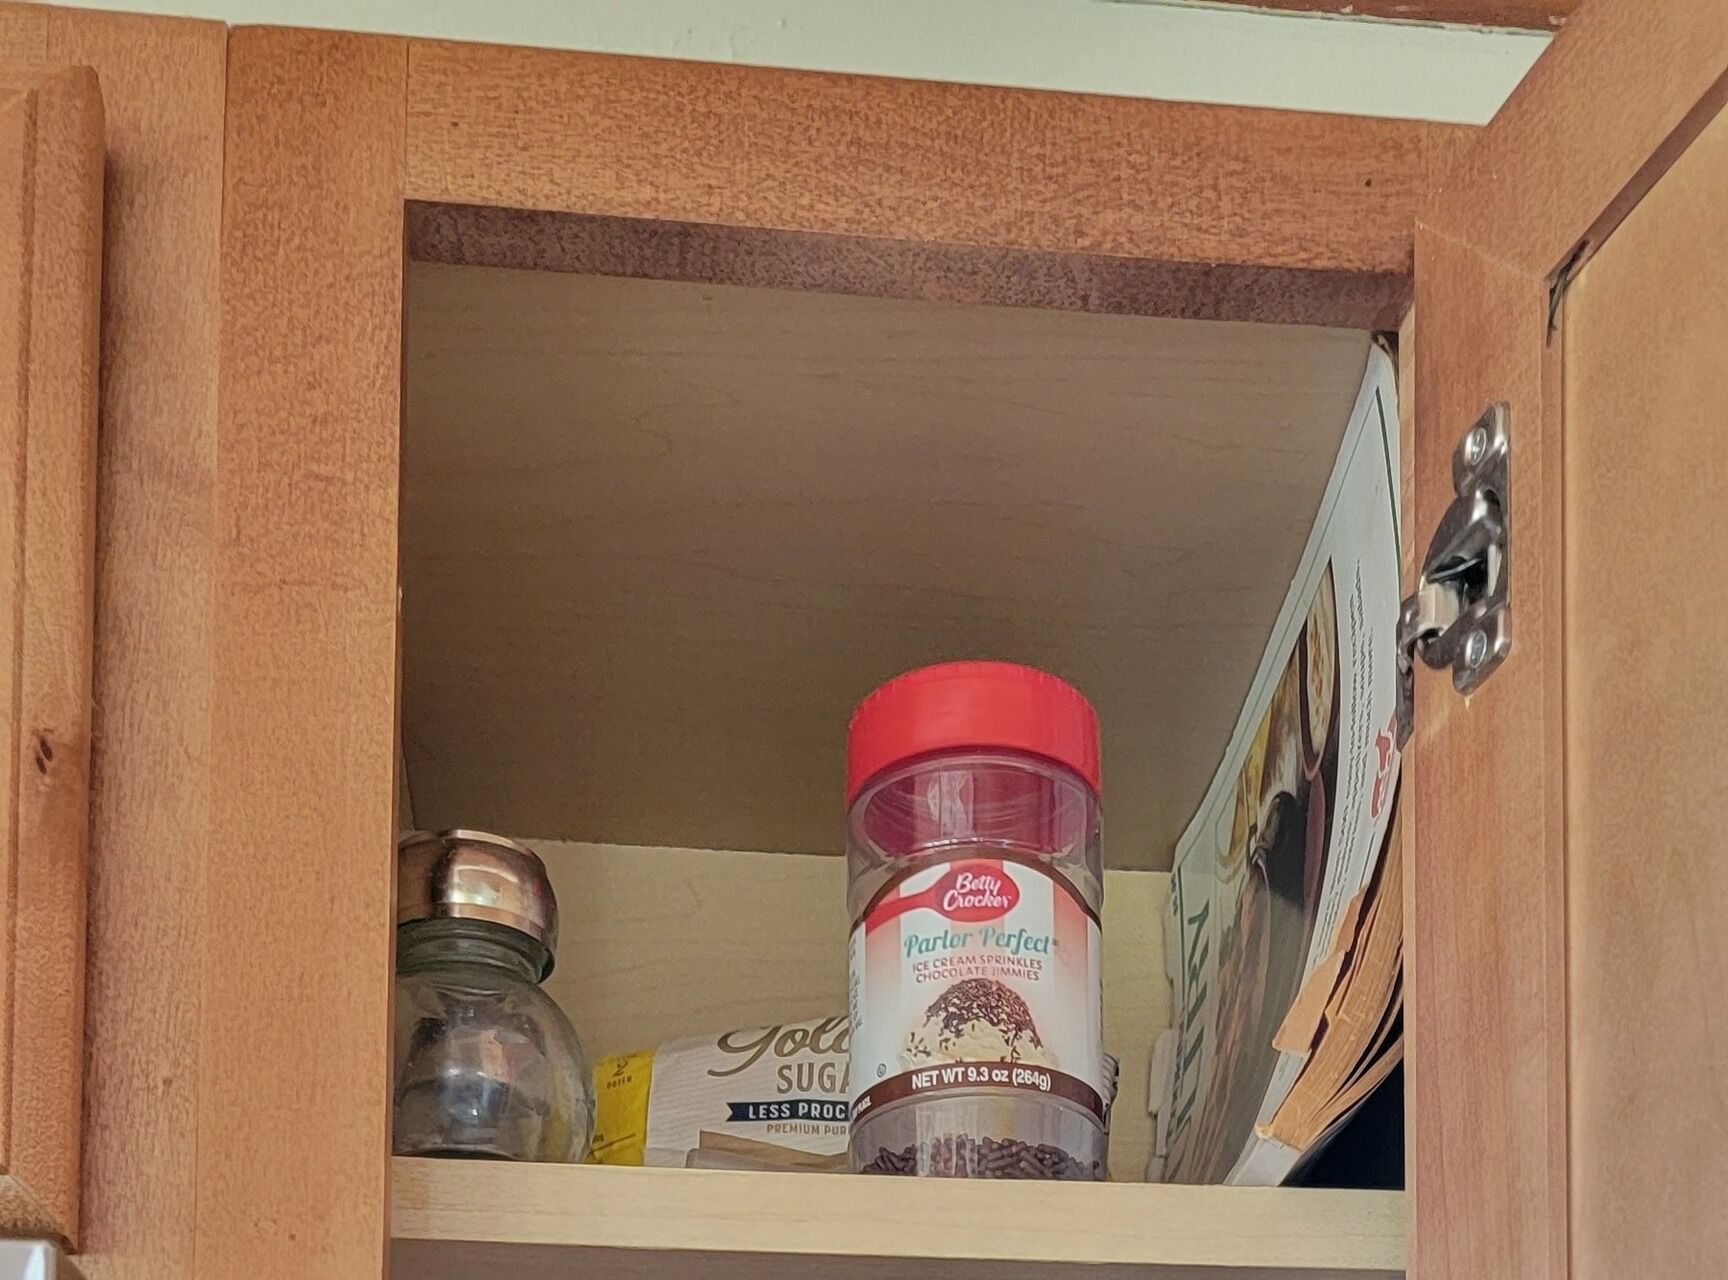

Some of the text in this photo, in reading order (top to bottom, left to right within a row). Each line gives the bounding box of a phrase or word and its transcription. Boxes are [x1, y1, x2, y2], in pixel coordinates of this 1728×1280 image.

[955, 872, 1002, 896] Betty
[943, 889, 1013, 911] Crocker
[904, 927, 1051, 958] Parlor Perfect
[912, 955, 1042, 973] ICE CREAM SPRINKLES
[916, 967, 1039, 983] CHOCOLATE JIMMIES
[912, 1067, 1051, 1092] NET WT 9.3 oz (264g)
[748, 1104, 791, 1118] LESS
[799, 1104, 846, 1118] PROC
[767, 1124, 820, 1134] PREMIUM
